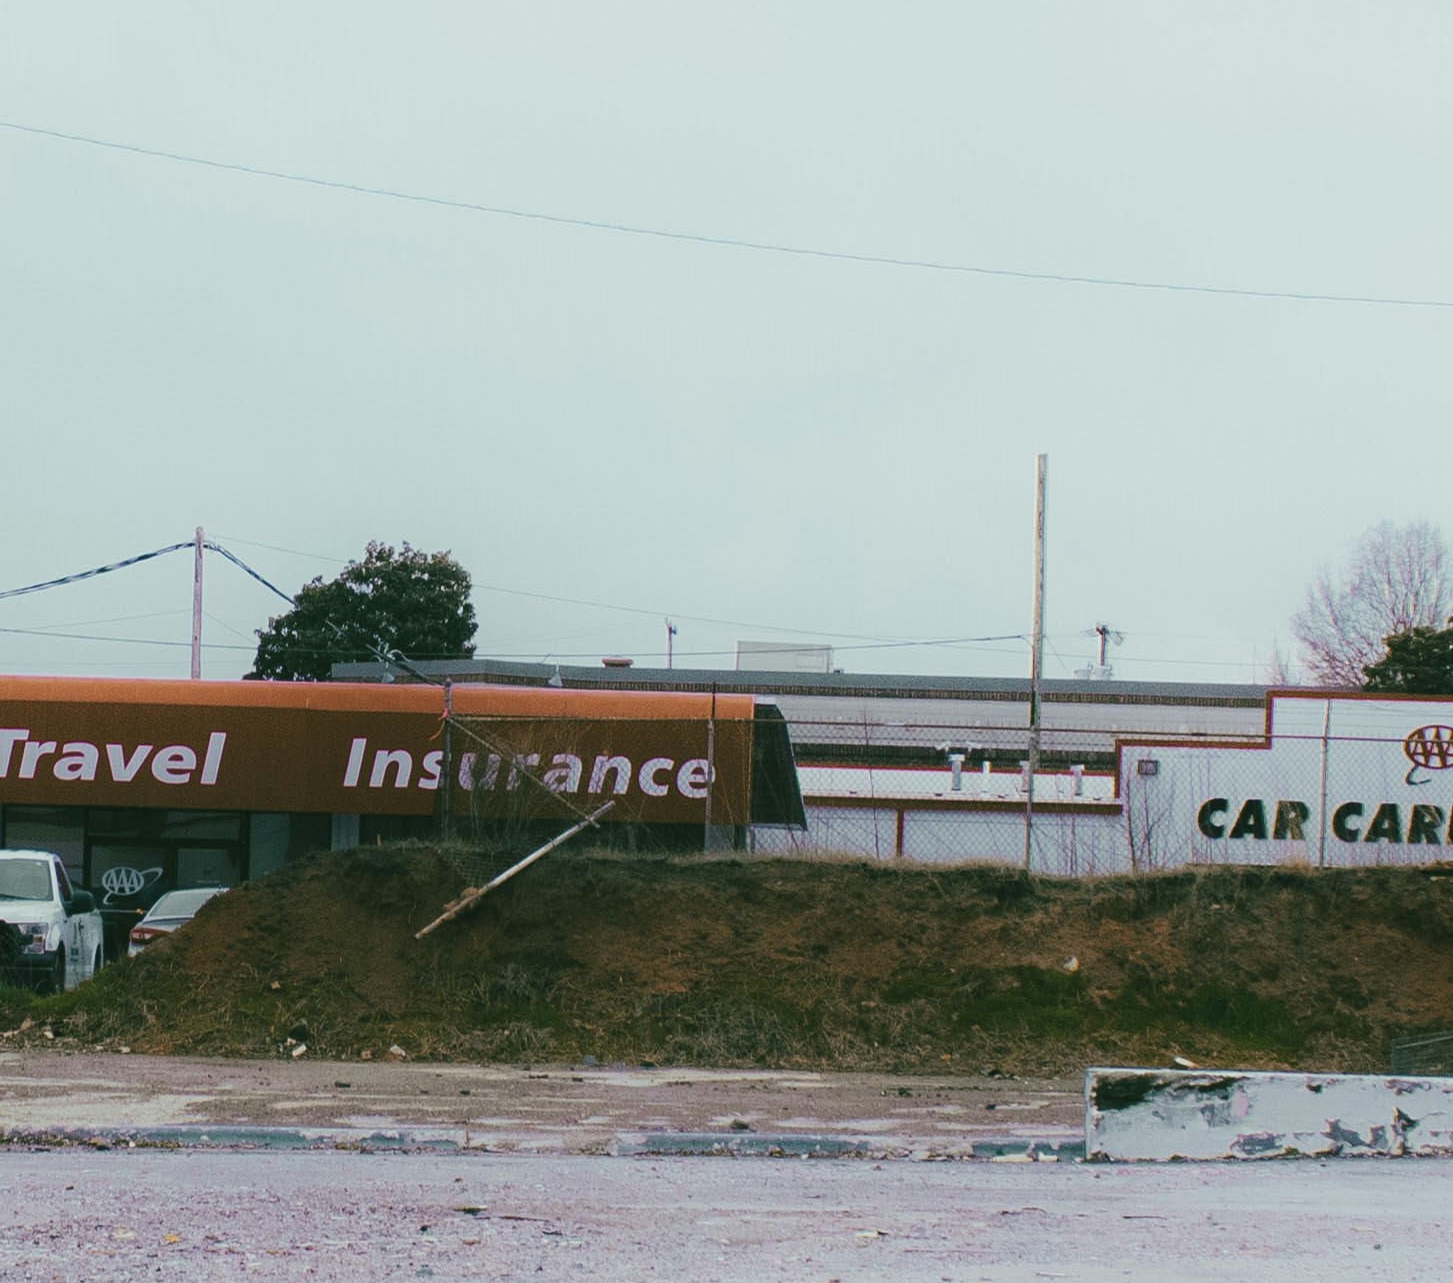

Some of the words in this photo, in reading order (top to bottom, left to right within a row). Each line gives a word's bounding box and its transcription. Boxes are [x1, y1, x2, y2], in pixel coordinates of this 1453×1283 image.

[342, 737, 717, 799] Insurance
[1196, 797, 1310, 841] CAR
[102, 867, 144, 896] AAA
